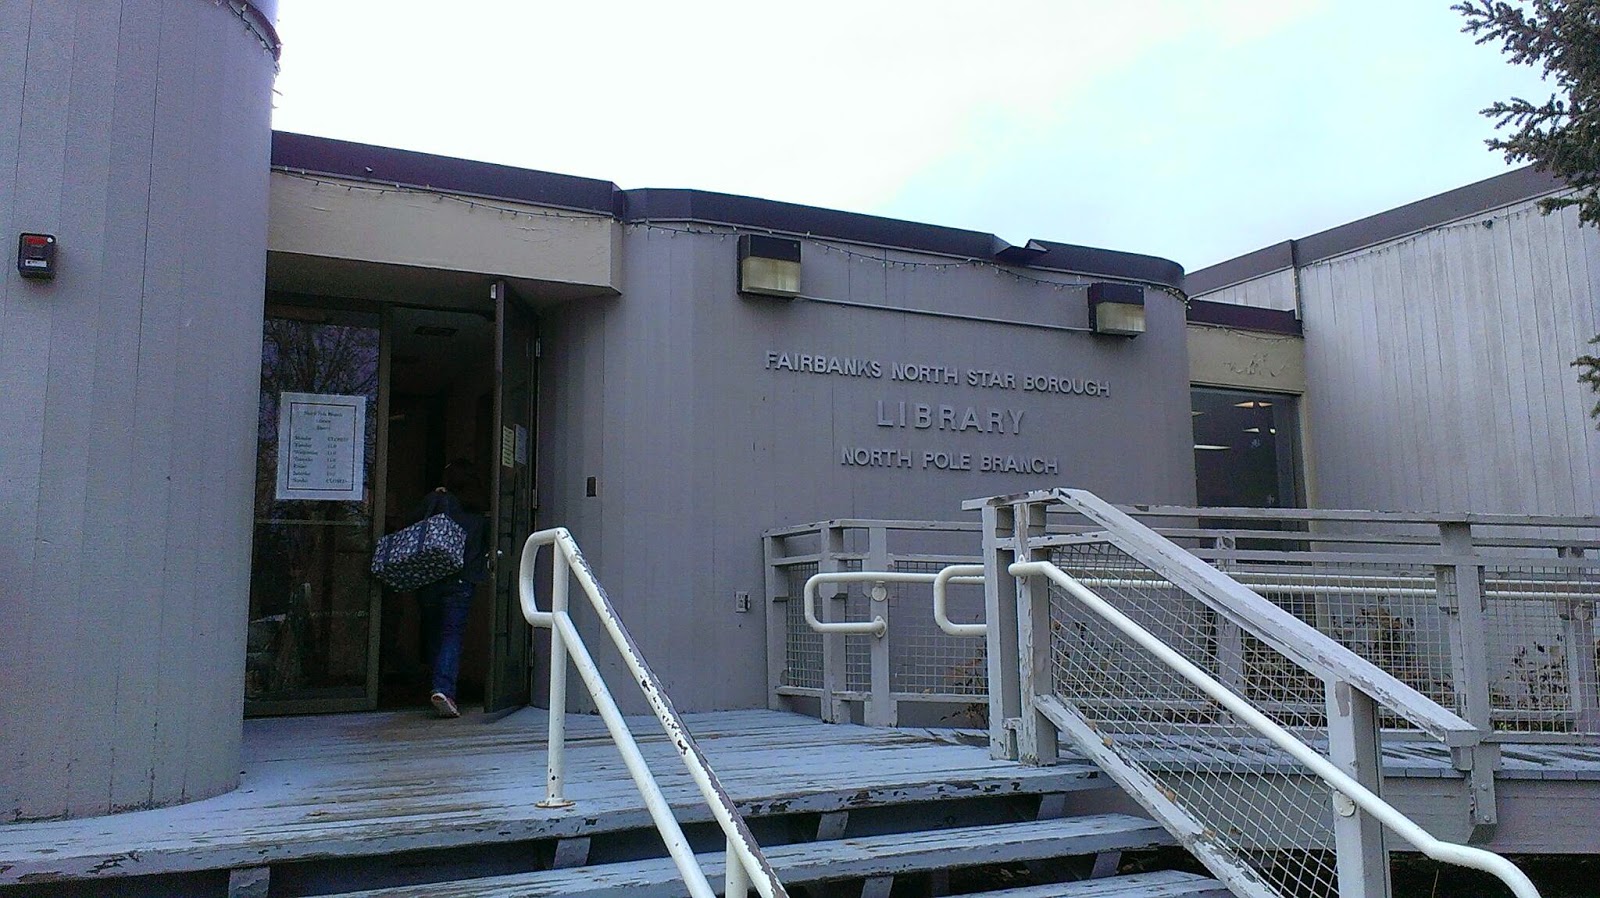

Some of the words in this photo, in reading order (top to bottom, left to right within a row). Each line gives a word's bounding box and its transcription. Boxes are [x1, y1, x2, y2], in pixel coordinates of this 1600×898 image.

[765, 350, 882, 379] FAIRBANKS
[891, 362, 959, 385] NORTH
[967, 371, 1016, 390] STAR
[1023, 376, 1110, 397] BOROUGH
[876, 400, 1026, 435] LIBRARY
[841, 447, 912, 468] NORTH
[922, 452, 971, 471] POLE
[980, 456, 1059, 475] BRANCH
